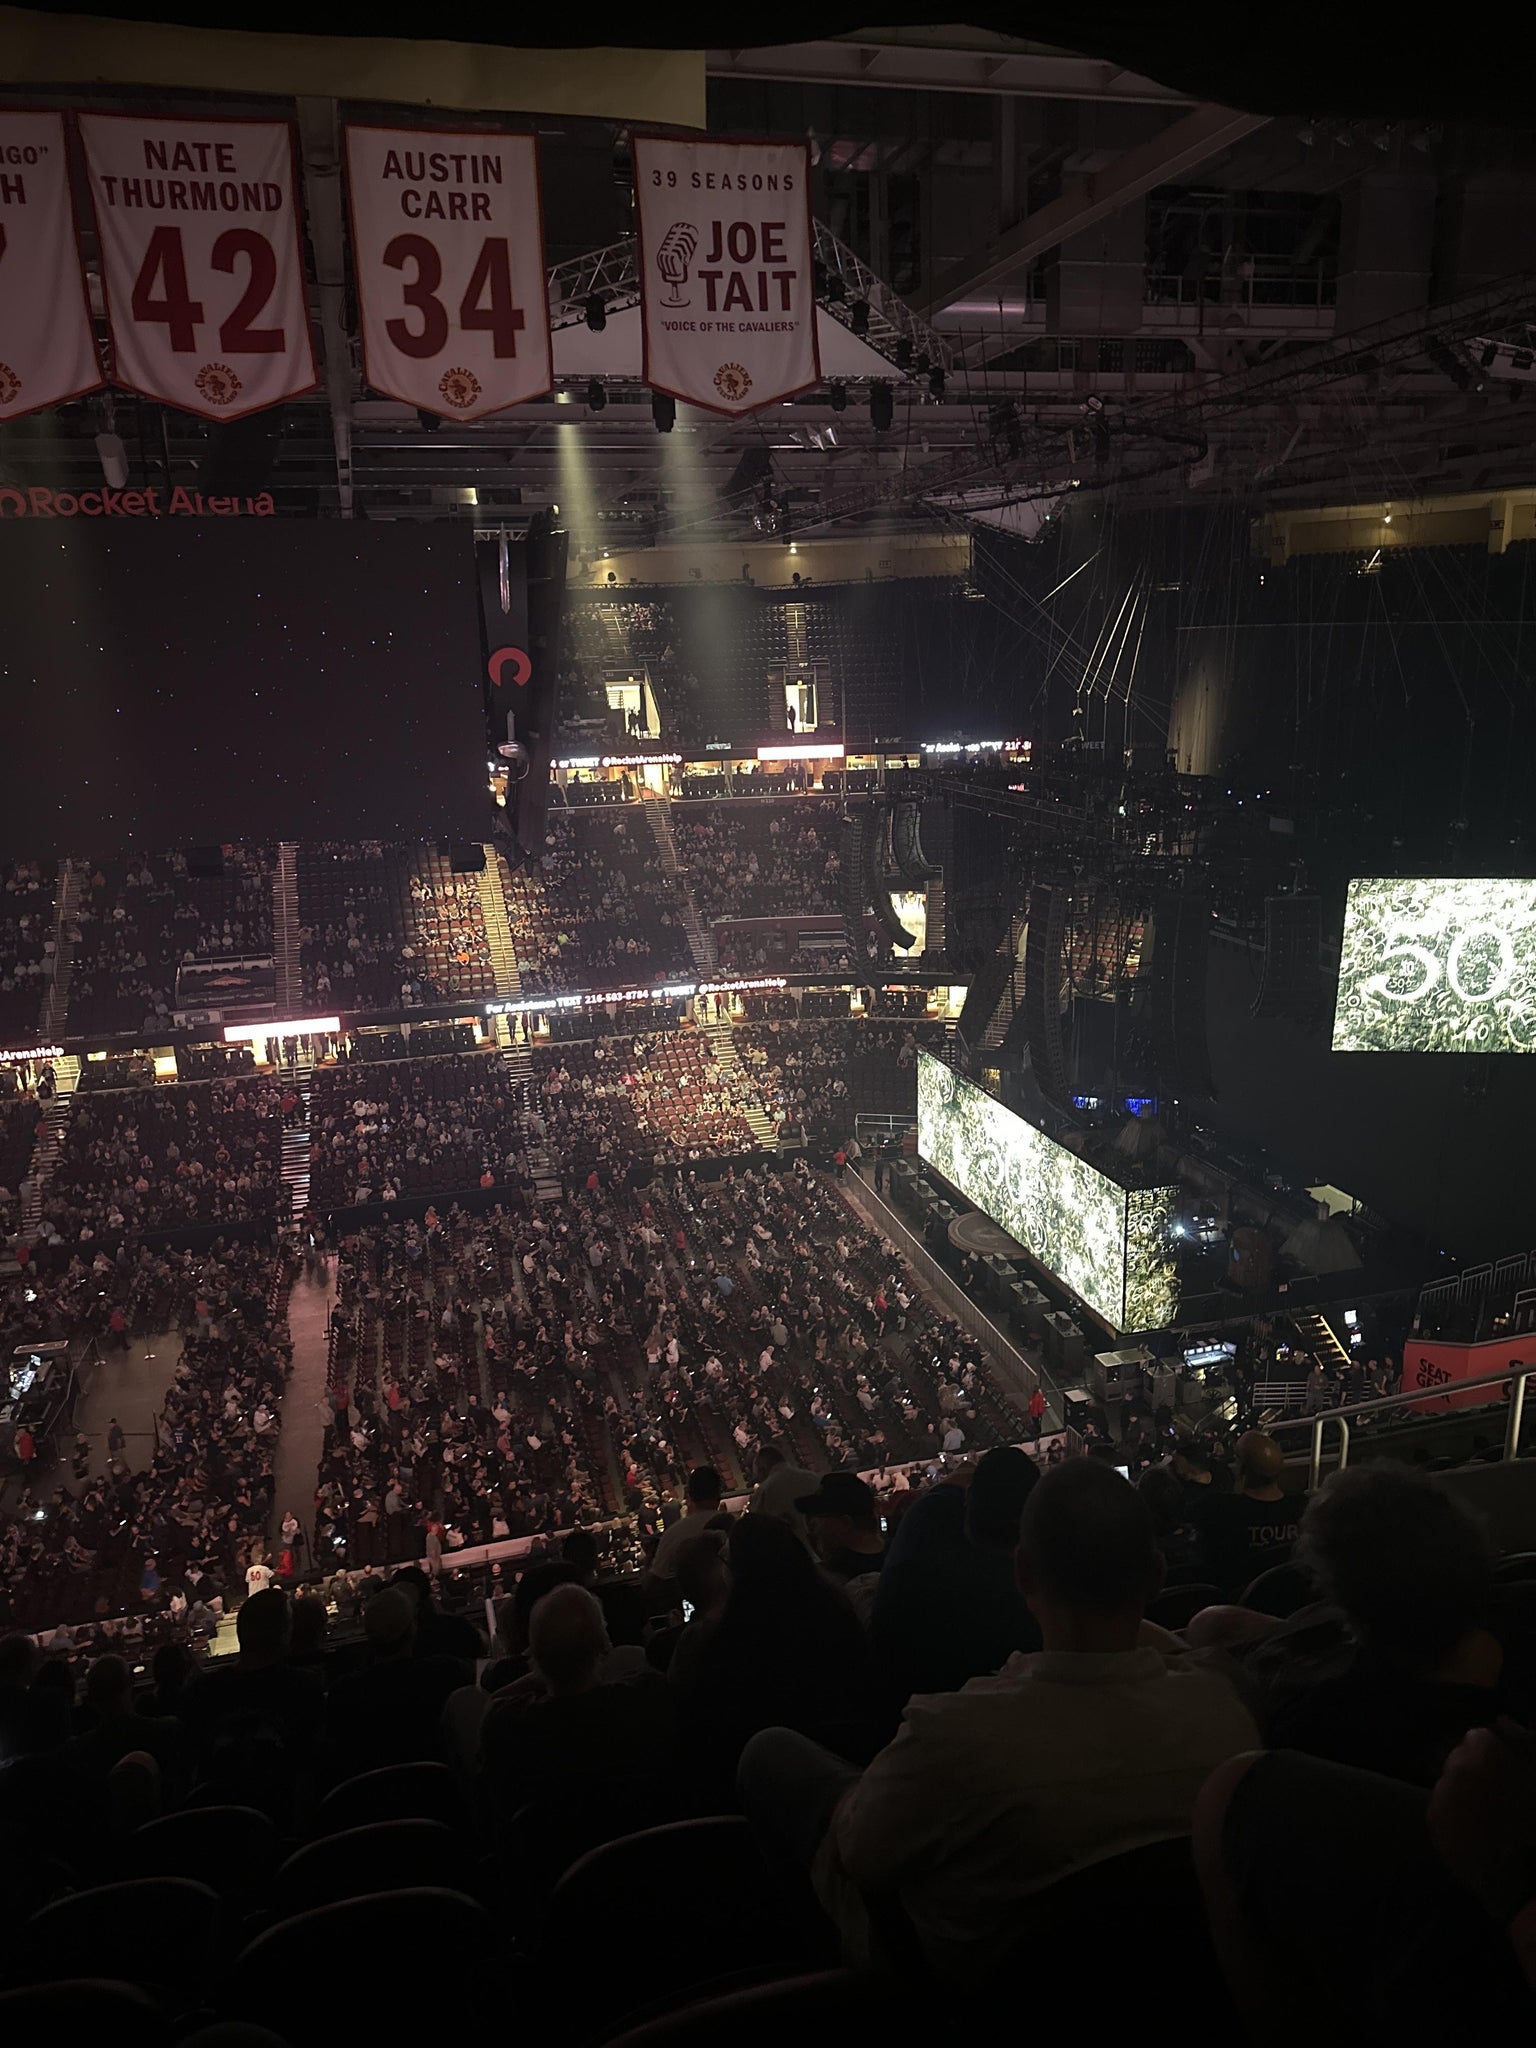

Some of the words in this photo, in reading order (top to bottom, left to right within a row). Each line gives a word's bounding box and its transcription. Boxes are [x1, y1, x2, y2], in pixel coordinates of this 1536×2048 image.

[144, 140, 237, 173] NATE
[382, 150, 503, 185] AUSTIN
[100, 175, 283, 212] THURMOND
[652, 169, 678, 188] 39
[691, 171, 795, 192] SEASONS
[400, 189, 493, 222] CARR
[706, 220, 788, 264] JOE
[131, 225, 286, 354] 42
[382, 232, 525, 360] 34
[698, 270, 797, 312] TAIT
[699, 322, 713, 332] OF
[716, 322, 735, 332] THE
[27, 486, 161, 517] Rocket
[558, 760, 570, 769] or
[569, 757, 600, 768] TWEET
[602, 752, 682, 768] @RocketArenaHelp
[1362, 923, 1515, 1003] 50
[486, 1003, 504, 1014] For
[504, 1000, 557, 1012] Assistance
[556, 995, 582, 1007] TEXT
[651, 989, 663, 998] or
[663, 984, 697, 997] TWEET
[698, 977, 787, 995] @RocketArenaHelp
[1419, 1358, 1453, 1386] SEAT
